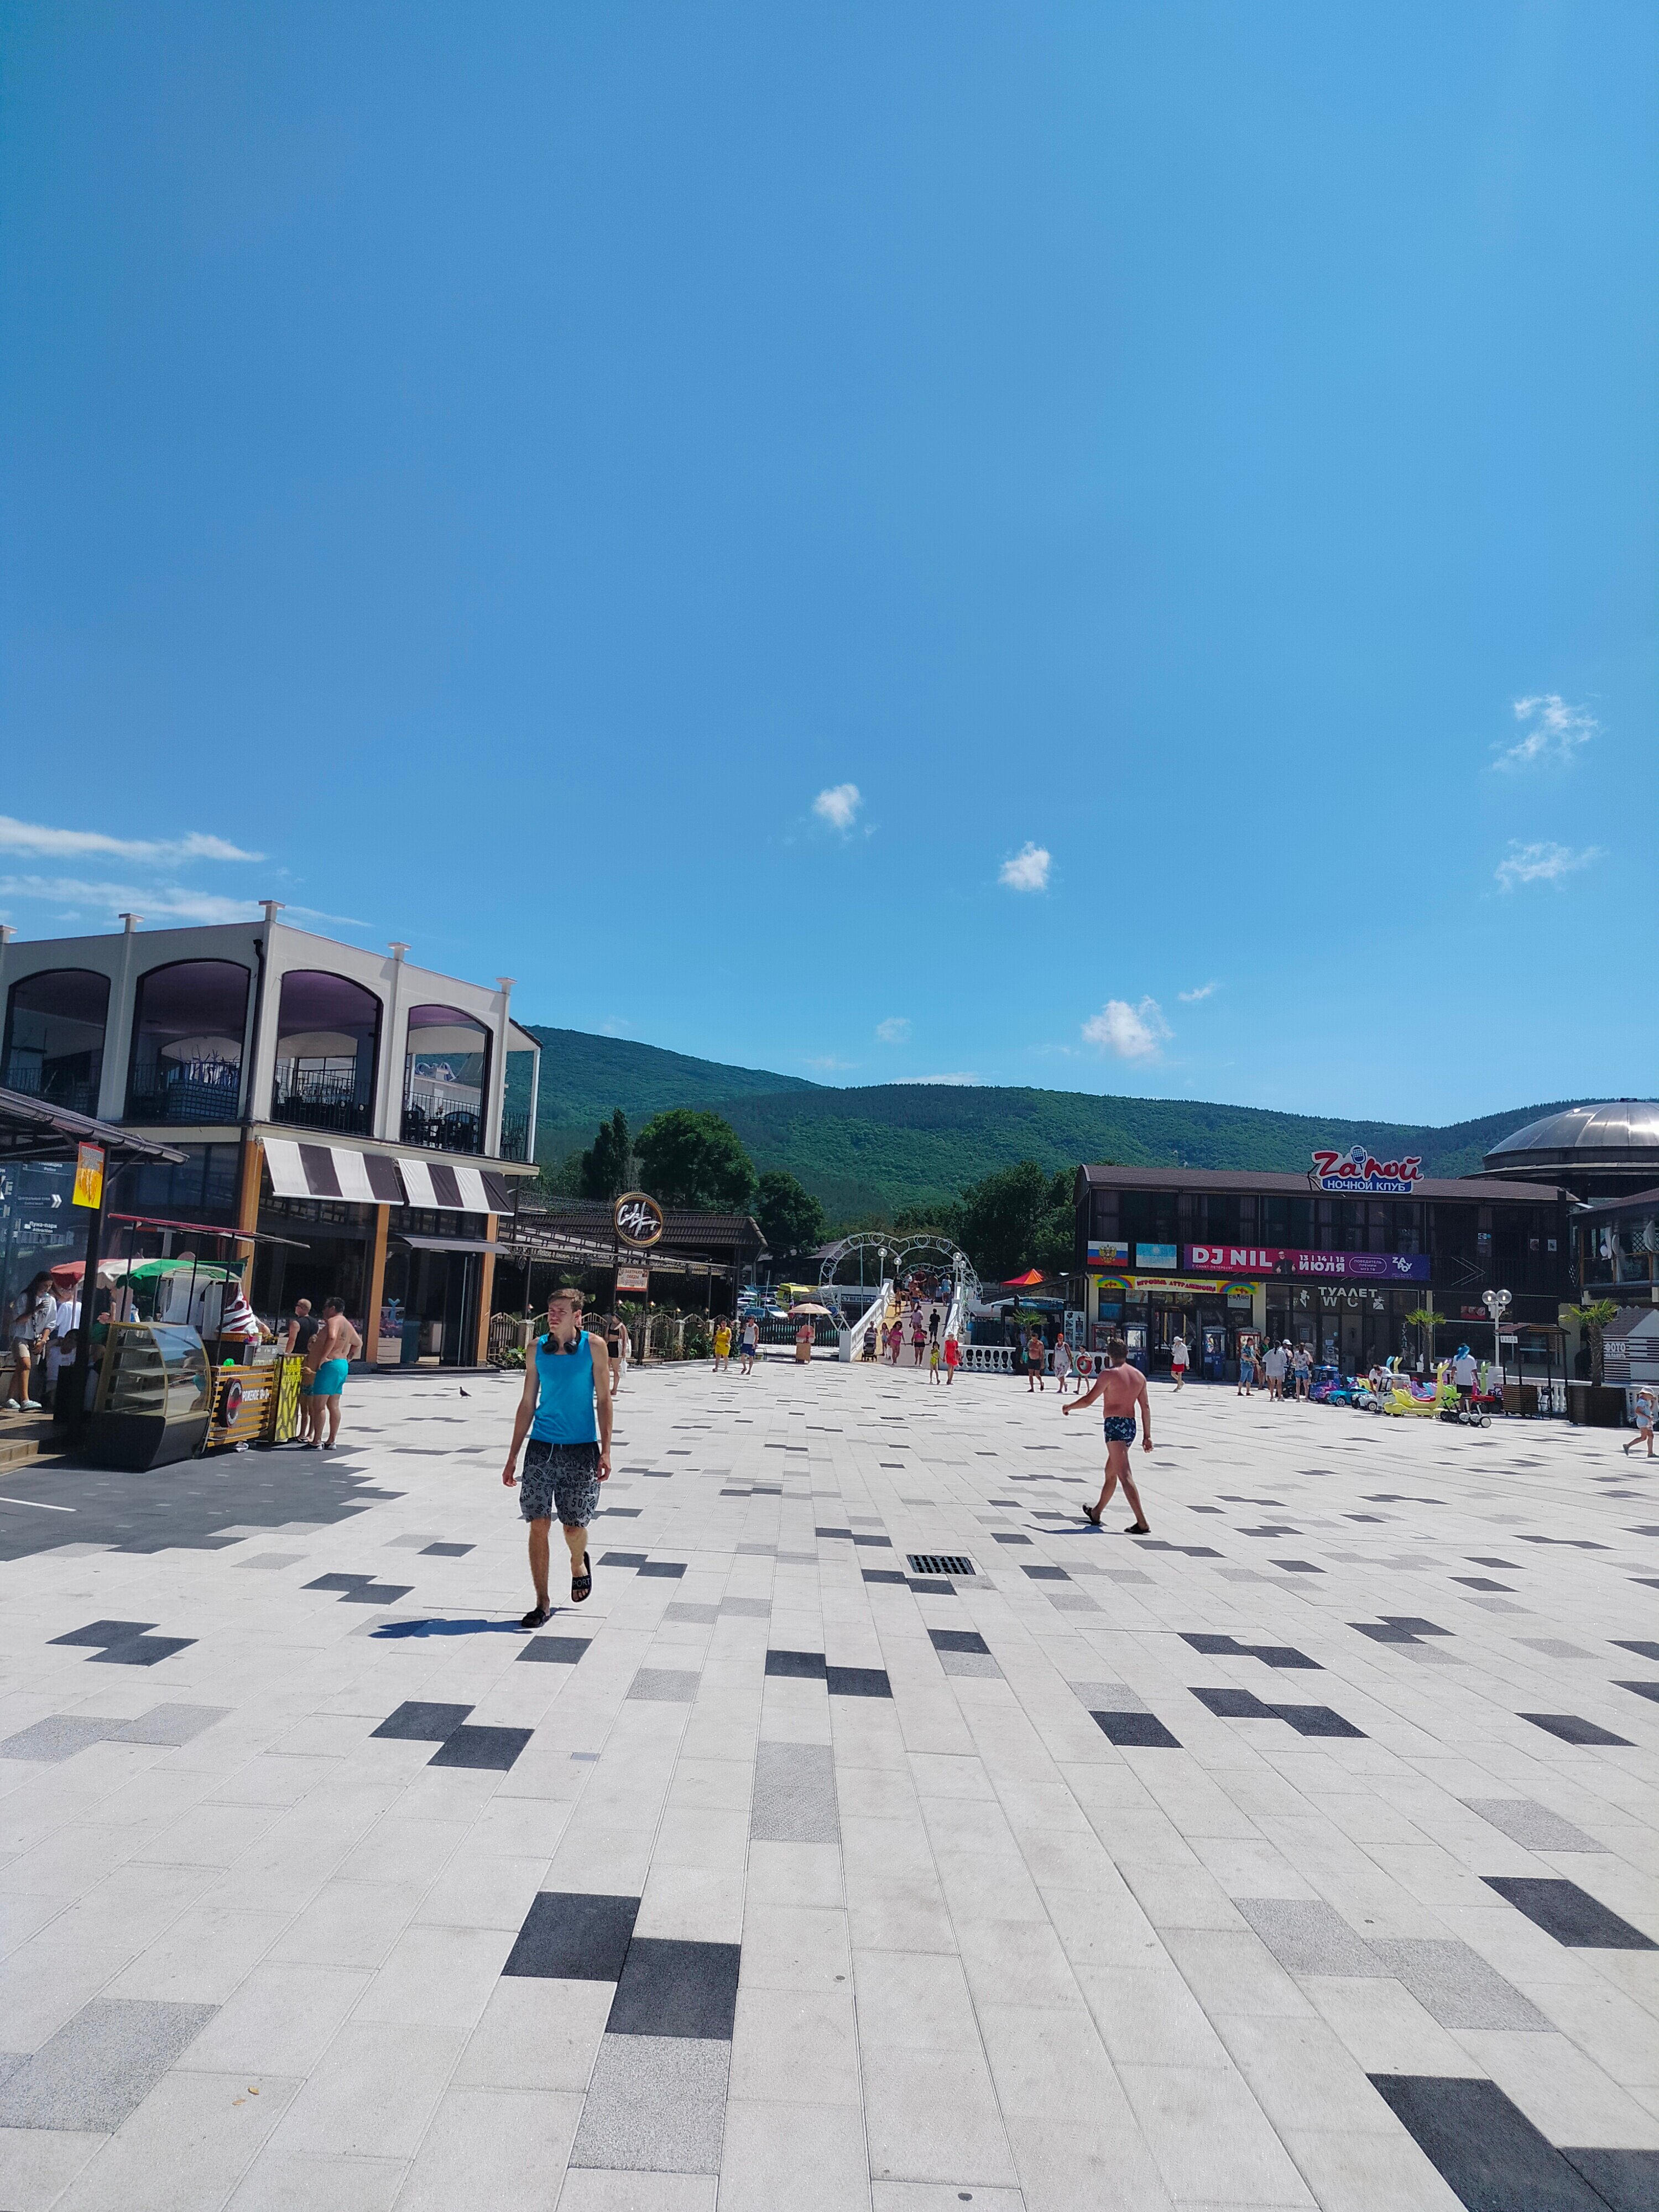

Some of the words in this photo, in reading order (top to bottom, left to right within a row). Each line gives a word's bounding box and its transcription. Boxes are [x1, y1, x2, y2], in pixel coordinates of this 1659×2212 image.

[1328, 1180, 1373, 1190] НОЧНОЙ
[1376, 1182, 1406, 1191] КЛУБ
[1192, 1247, 1224, 1264] DJ
[1230, 1250, 1272, 1267] NIL
[1300, 1261, 1345, 1272] ИЮЛЯ
[1318, 1286, 1378, 1298] ТУАЛЕТ
[1605, 1343, 1626, 1352] ФОТО
